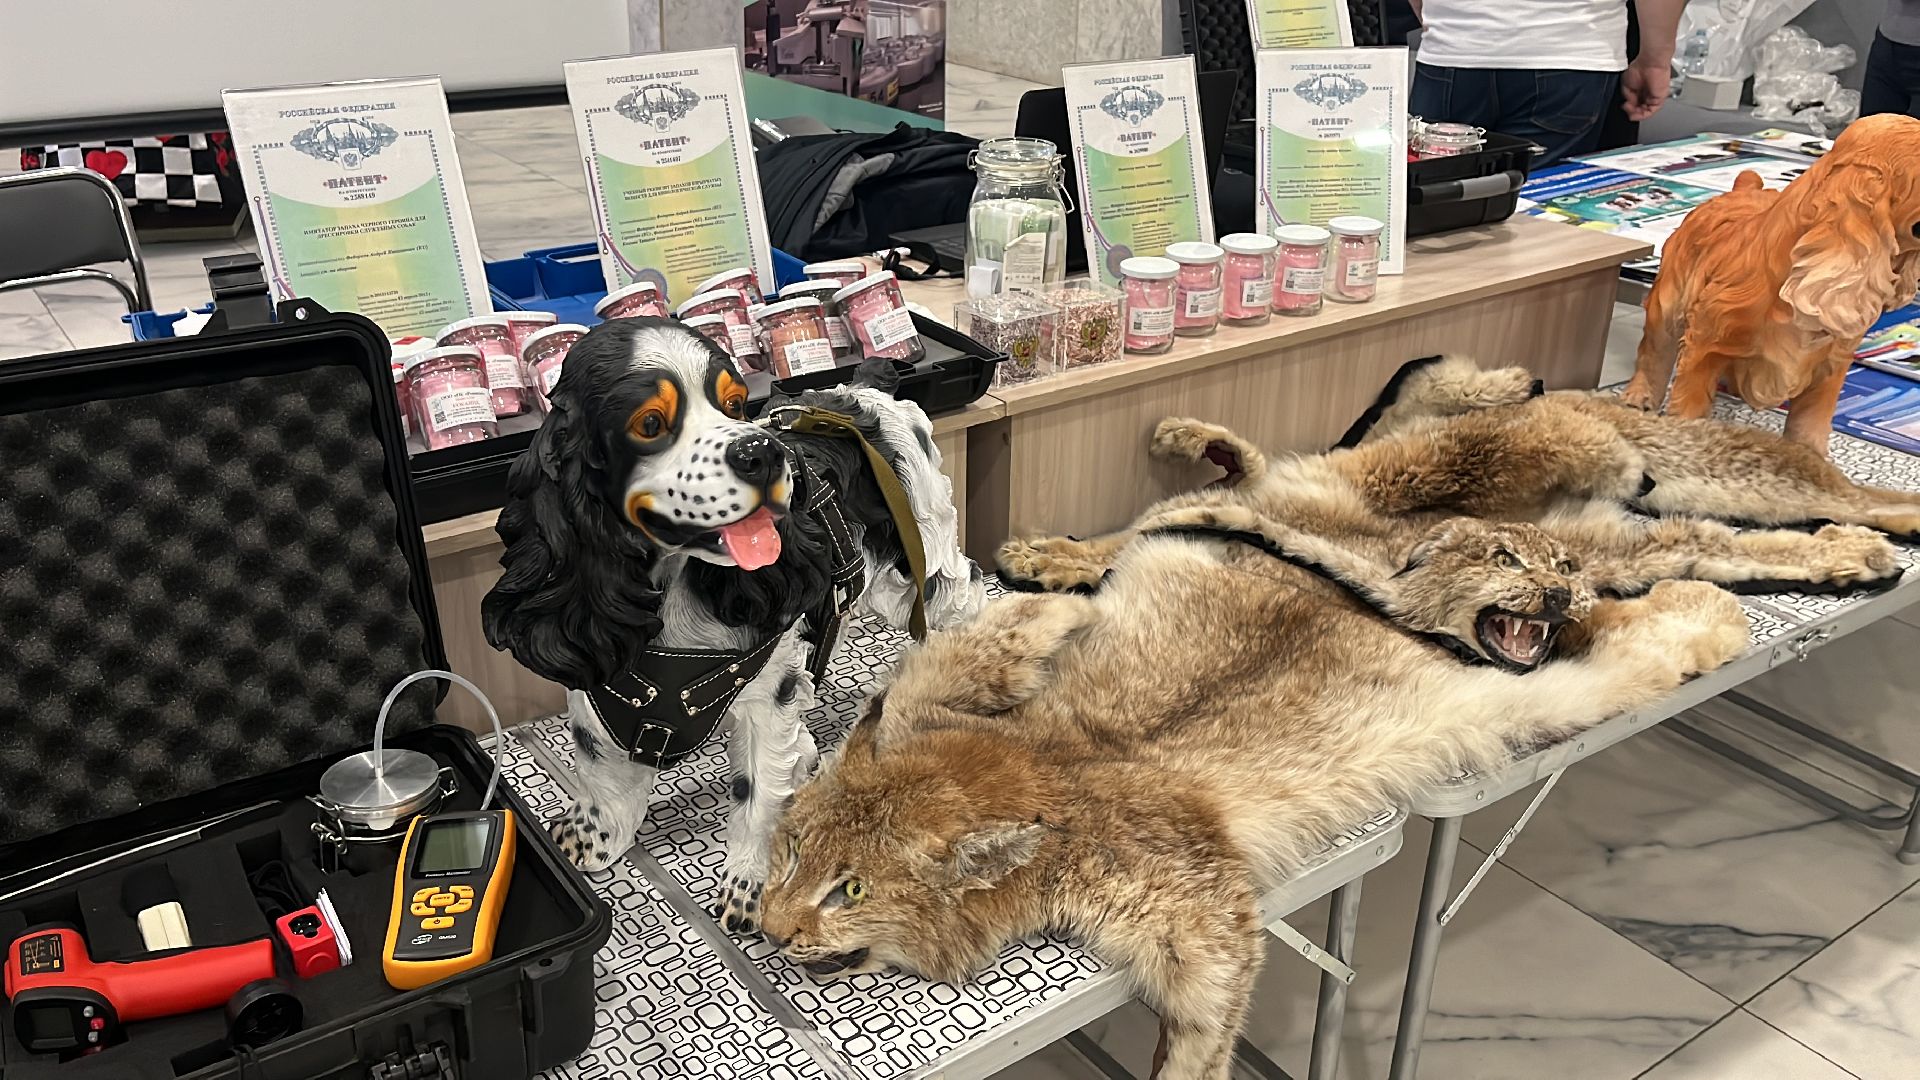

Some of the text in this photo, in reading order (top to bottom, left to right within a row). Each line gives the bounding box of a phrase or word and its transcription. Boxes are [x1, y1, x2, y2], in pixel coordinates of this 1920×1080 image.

[606, 69, 699, 84] РОССИЙСКАЯ ФЕДЕРАЦИЯ
[278, 102, 396, 118] РОССИЙСКАЯ ФЕДЕРАЦИЯ
[1311, 117, 1350, 126] ПАТЕНТ
[643, 136, 687, 150] ПАТЕНТ
[1120, 131, 1152, 142] ПАТЕНТ
[328, 174, 382, 189] ПАТЕНТ
[303, 226, 337, 235] ИМИТАТОР
[337, 223, 360, 231] ЗАПАХА
[360, 220, 388, 229] ЧЕРНОГО
[388, 217, 414, 225] ГЕРОИНА
[317, 231, 359, 239] ДРЕССИРОВКИ
[360, 225, 397, 234] СЛУЖЕБНЫХ
